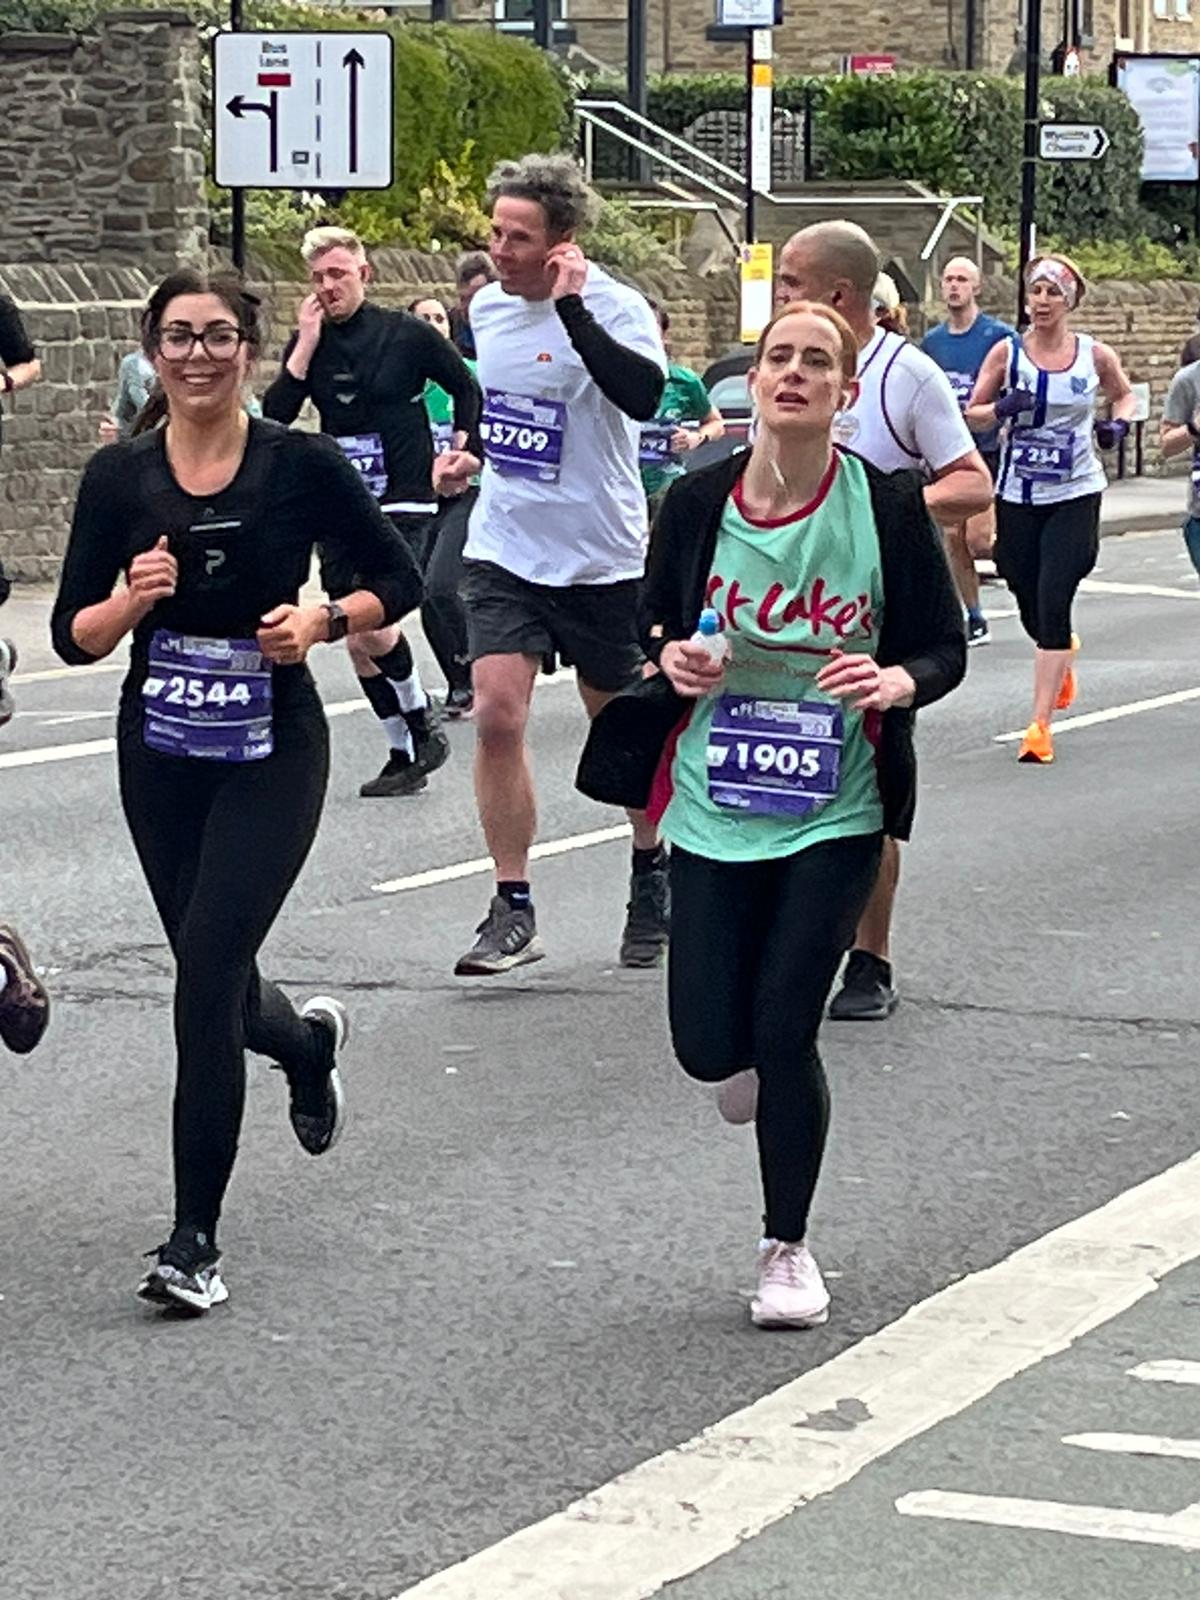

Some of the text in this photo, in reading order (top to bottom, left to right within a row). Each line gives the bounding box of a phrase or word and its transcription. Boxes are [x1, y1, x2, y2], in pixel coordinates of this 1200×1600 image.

[490, 423, 549, 452] 5709
[756, 578, 873, 640] Luke's
[165, 676, 252, 708] 2544
[736, 741, 820, 777] 1905
